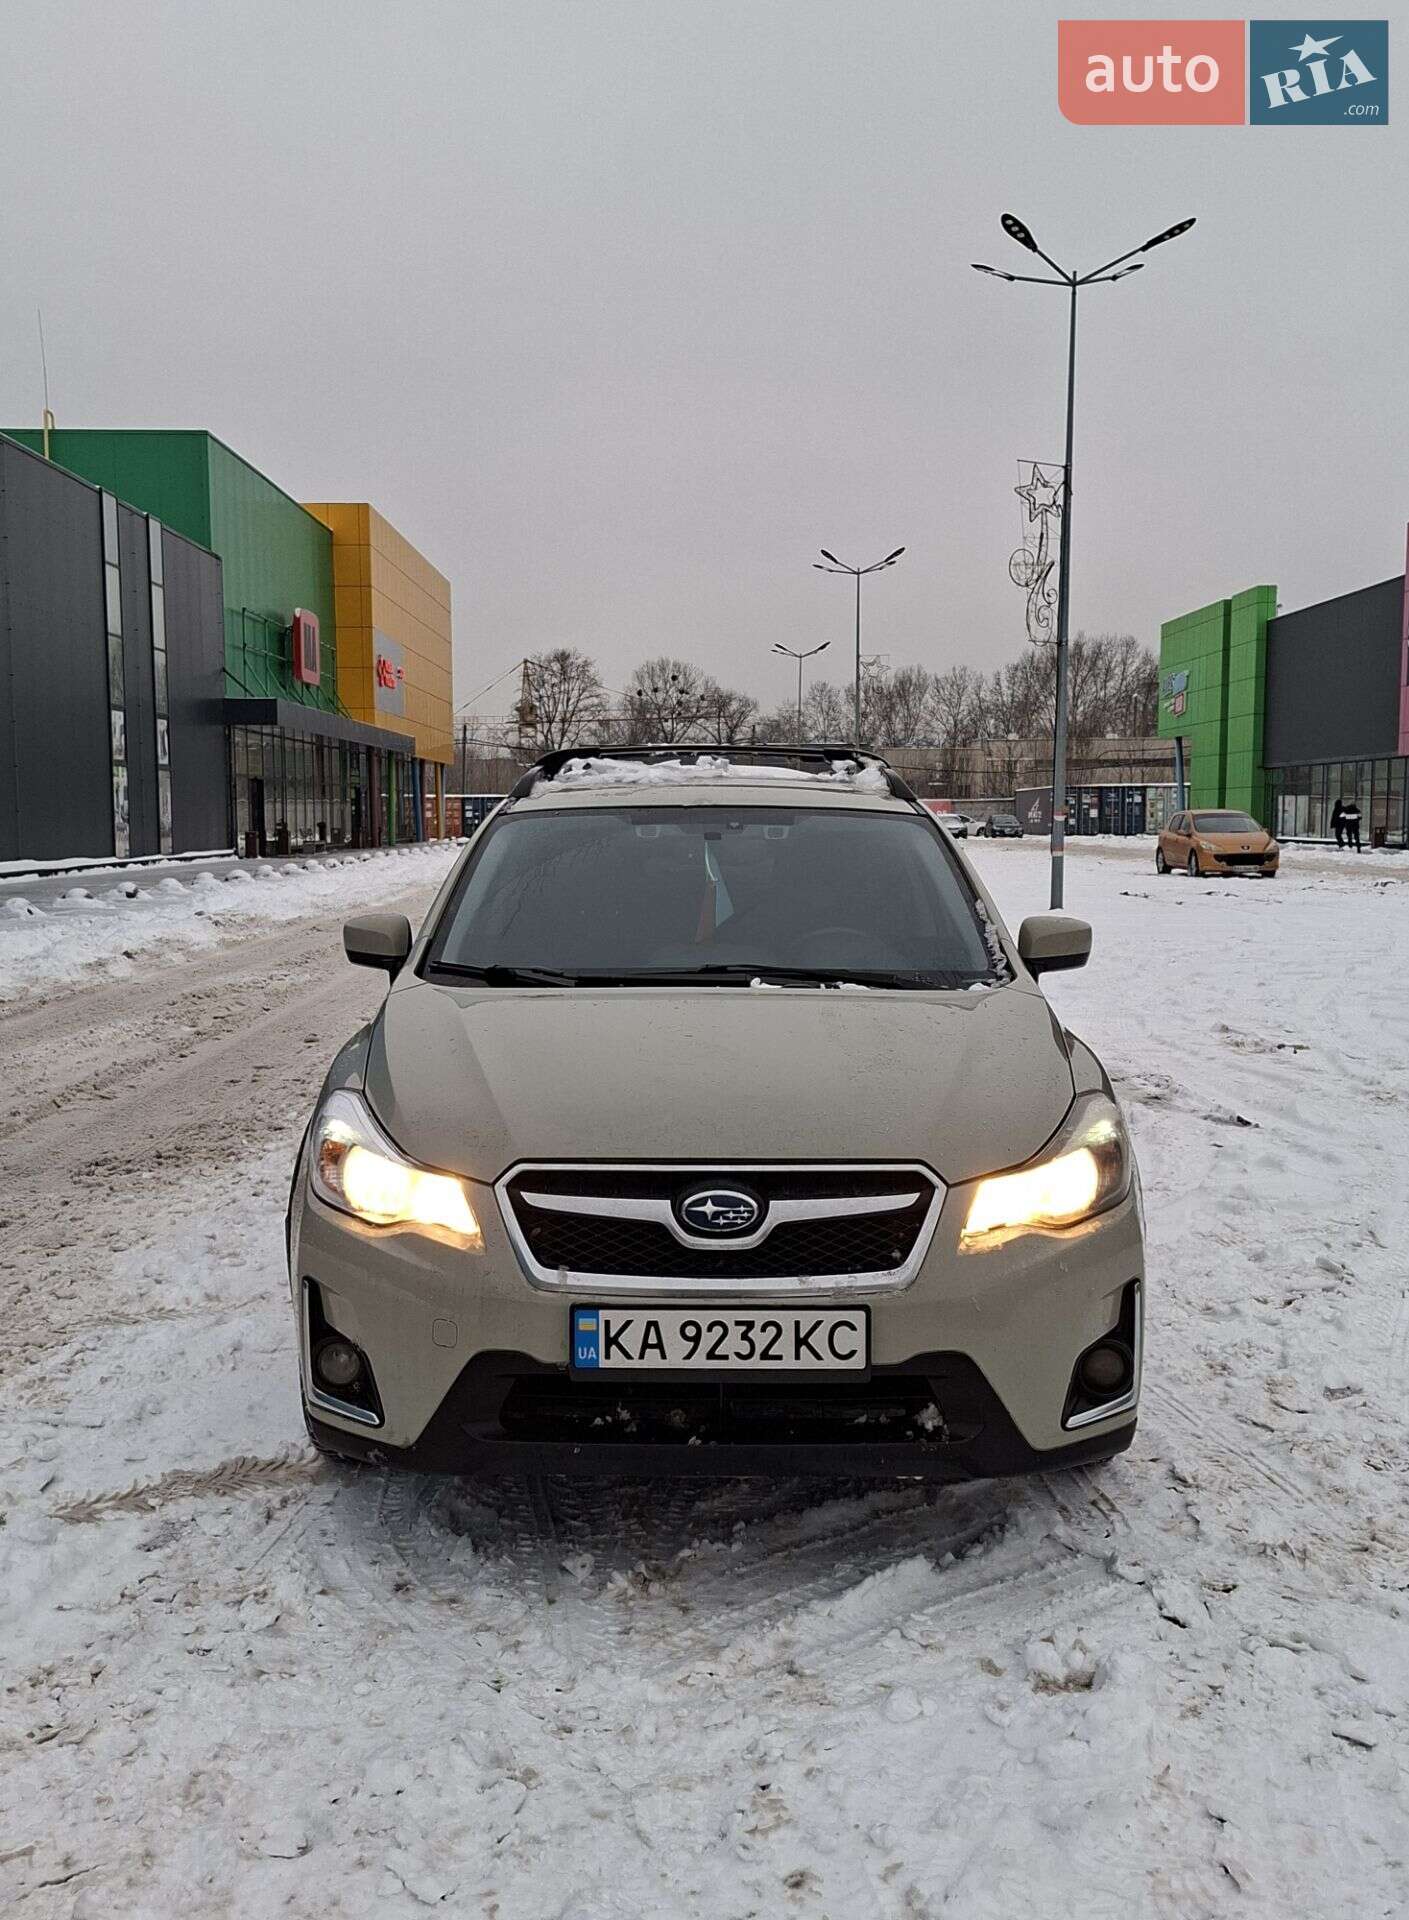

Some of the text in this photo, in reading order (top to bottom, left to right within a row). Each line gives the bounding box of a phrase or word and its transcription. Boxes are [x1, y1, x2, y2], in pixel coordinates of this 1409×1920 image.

[578, 1347, 597, 1361] UA
[604, 1319, 858, 1361] KA 9232 KC
